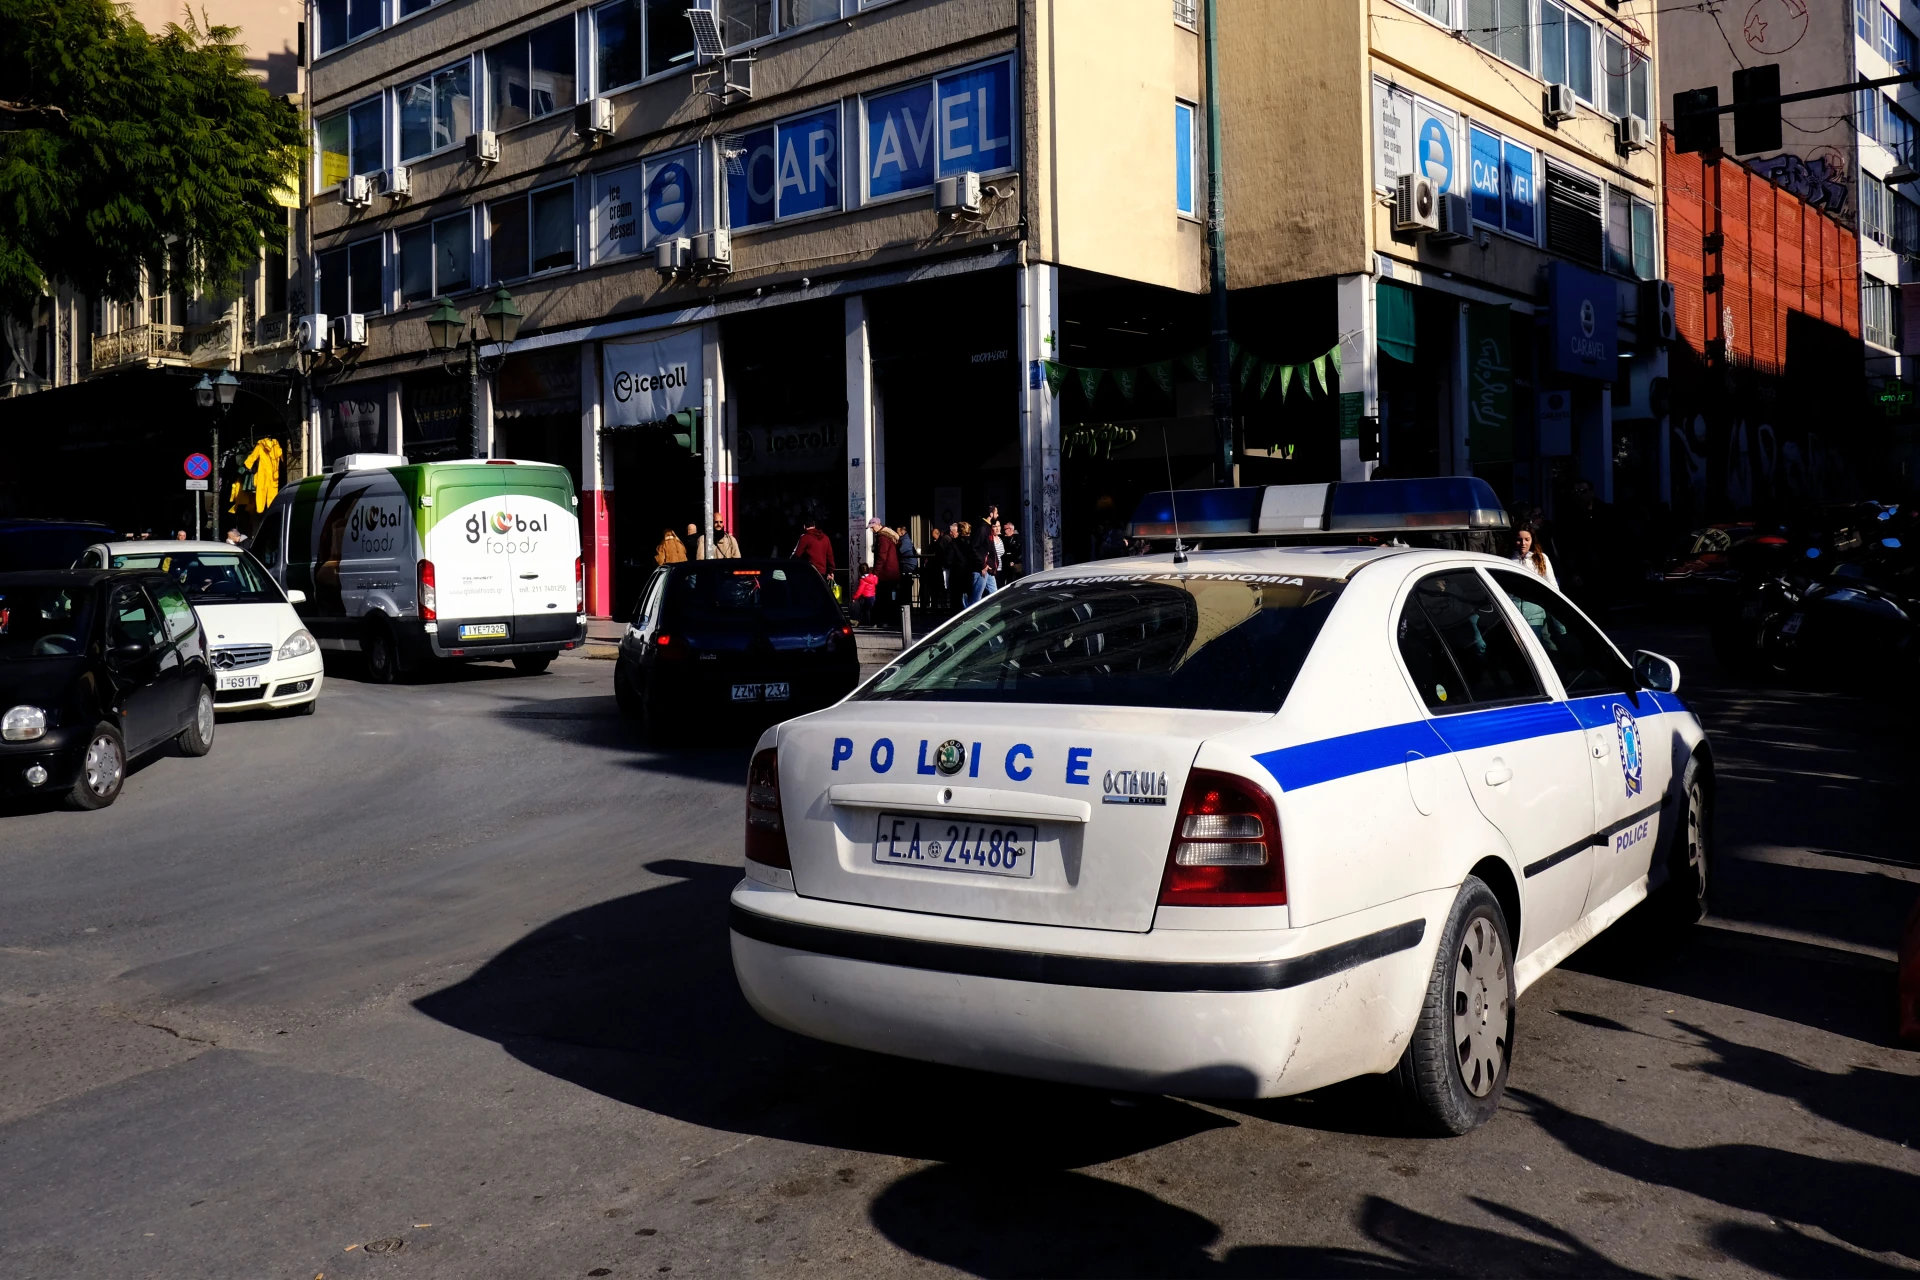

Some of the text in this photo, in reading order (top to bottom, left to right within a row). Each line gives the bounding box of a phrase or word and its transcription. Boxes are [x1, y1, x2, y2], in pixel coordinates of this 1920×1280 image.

[609, 185, 621, 202] ice
[1473, 158, 1533, 208] CARAVEL
[609, 202, 632, 221] cream
[609, 219, 636, 241] dessert
[1571, 336, 1608, 361] CARAVEL
[635, 366, 688, 394] iceroll
[1541, 411, 1571, 421] CARAVEL
[767, 424, 841, 453] iceroll
[350, 504, 403, 543] global
[465, 511, 548, 543] global
[361, 532, 395, 553] foods
[486, 537, 538, 554] foods
[532, 585, 542, 593] 211
[1029, 574, 1304, 590] ΕΛΛΗΝΙΚΗ ΑΣΤΥΝΟΜΙΑ
[831, 737, 1092, 785] POLICE
[1103, 769, 1169, 796] OCTAVIA
[944, 825, 1019, 869] 24486
[1616, 821, 1649, 854] POLICE
